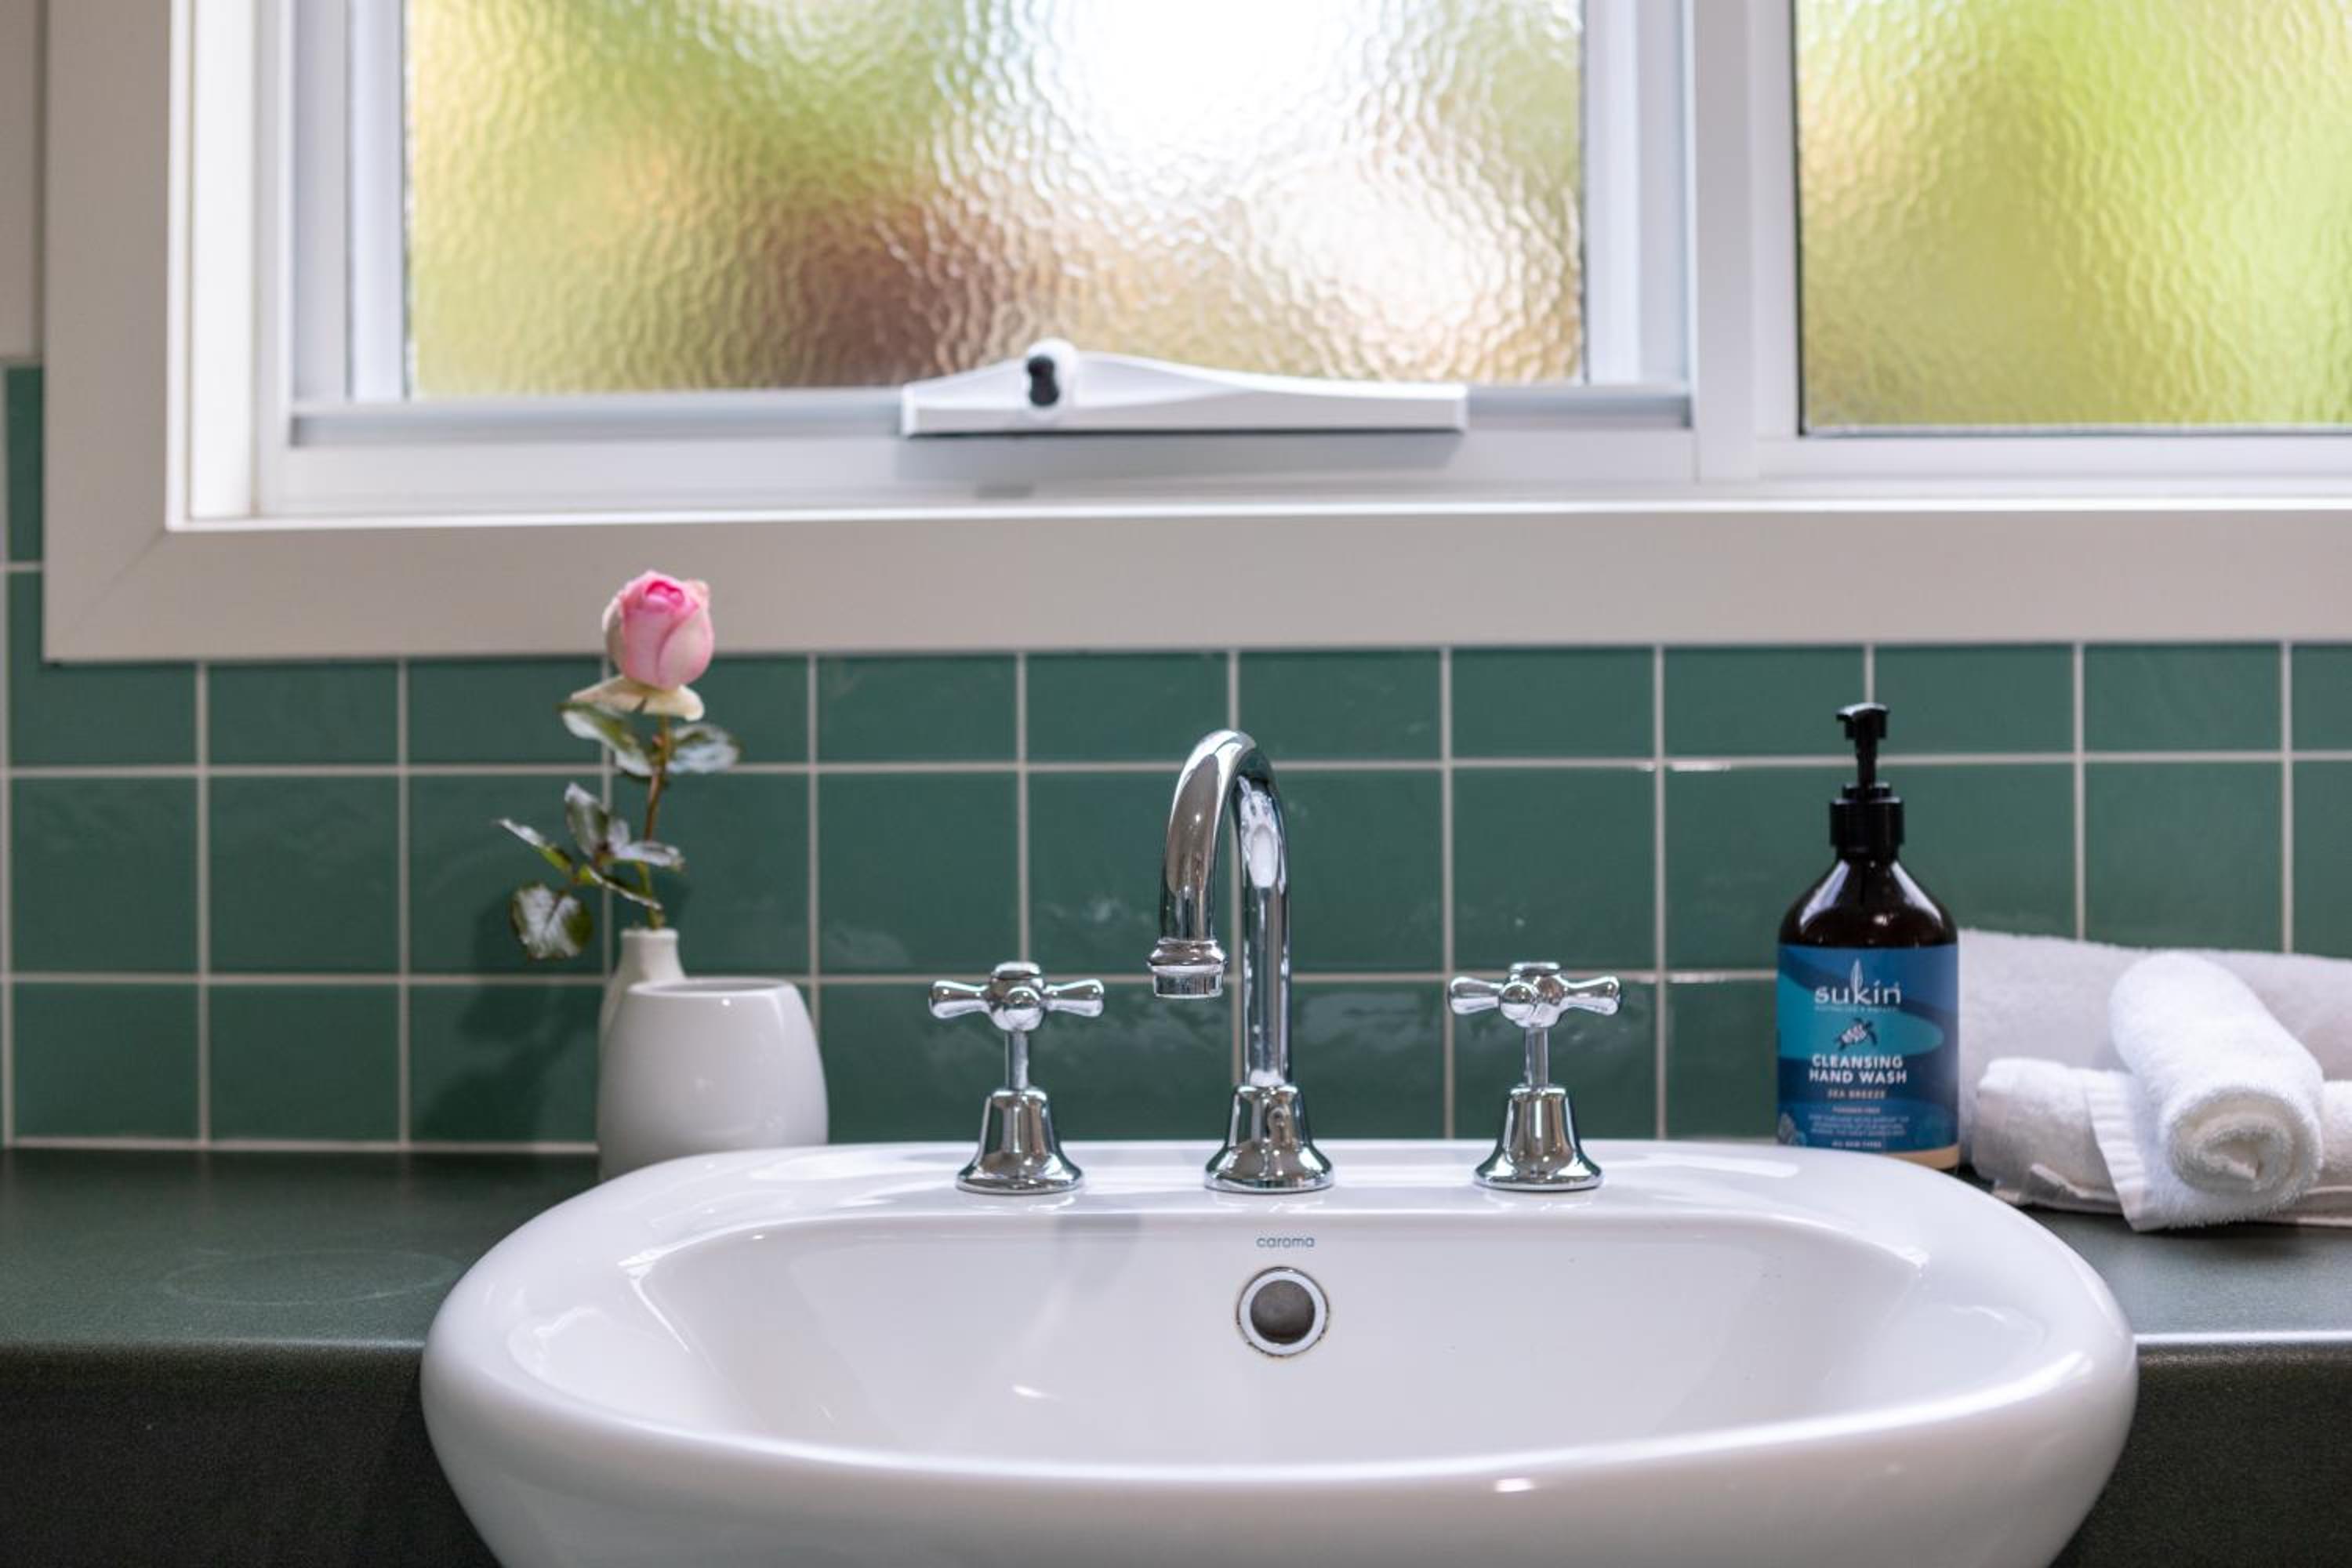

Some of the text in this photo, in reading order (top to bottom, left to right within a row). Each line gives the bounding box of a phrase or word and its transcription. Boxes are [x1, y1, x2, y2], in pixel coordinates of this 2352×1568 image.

[1814, 959, 1901, 1004] sukin
[1812, 1054, 1903, 1069] CLEANSING
[1809, 1069, 1907, 1083] HAND WASH
[1256, 1236, 1315, 1248] caroma
